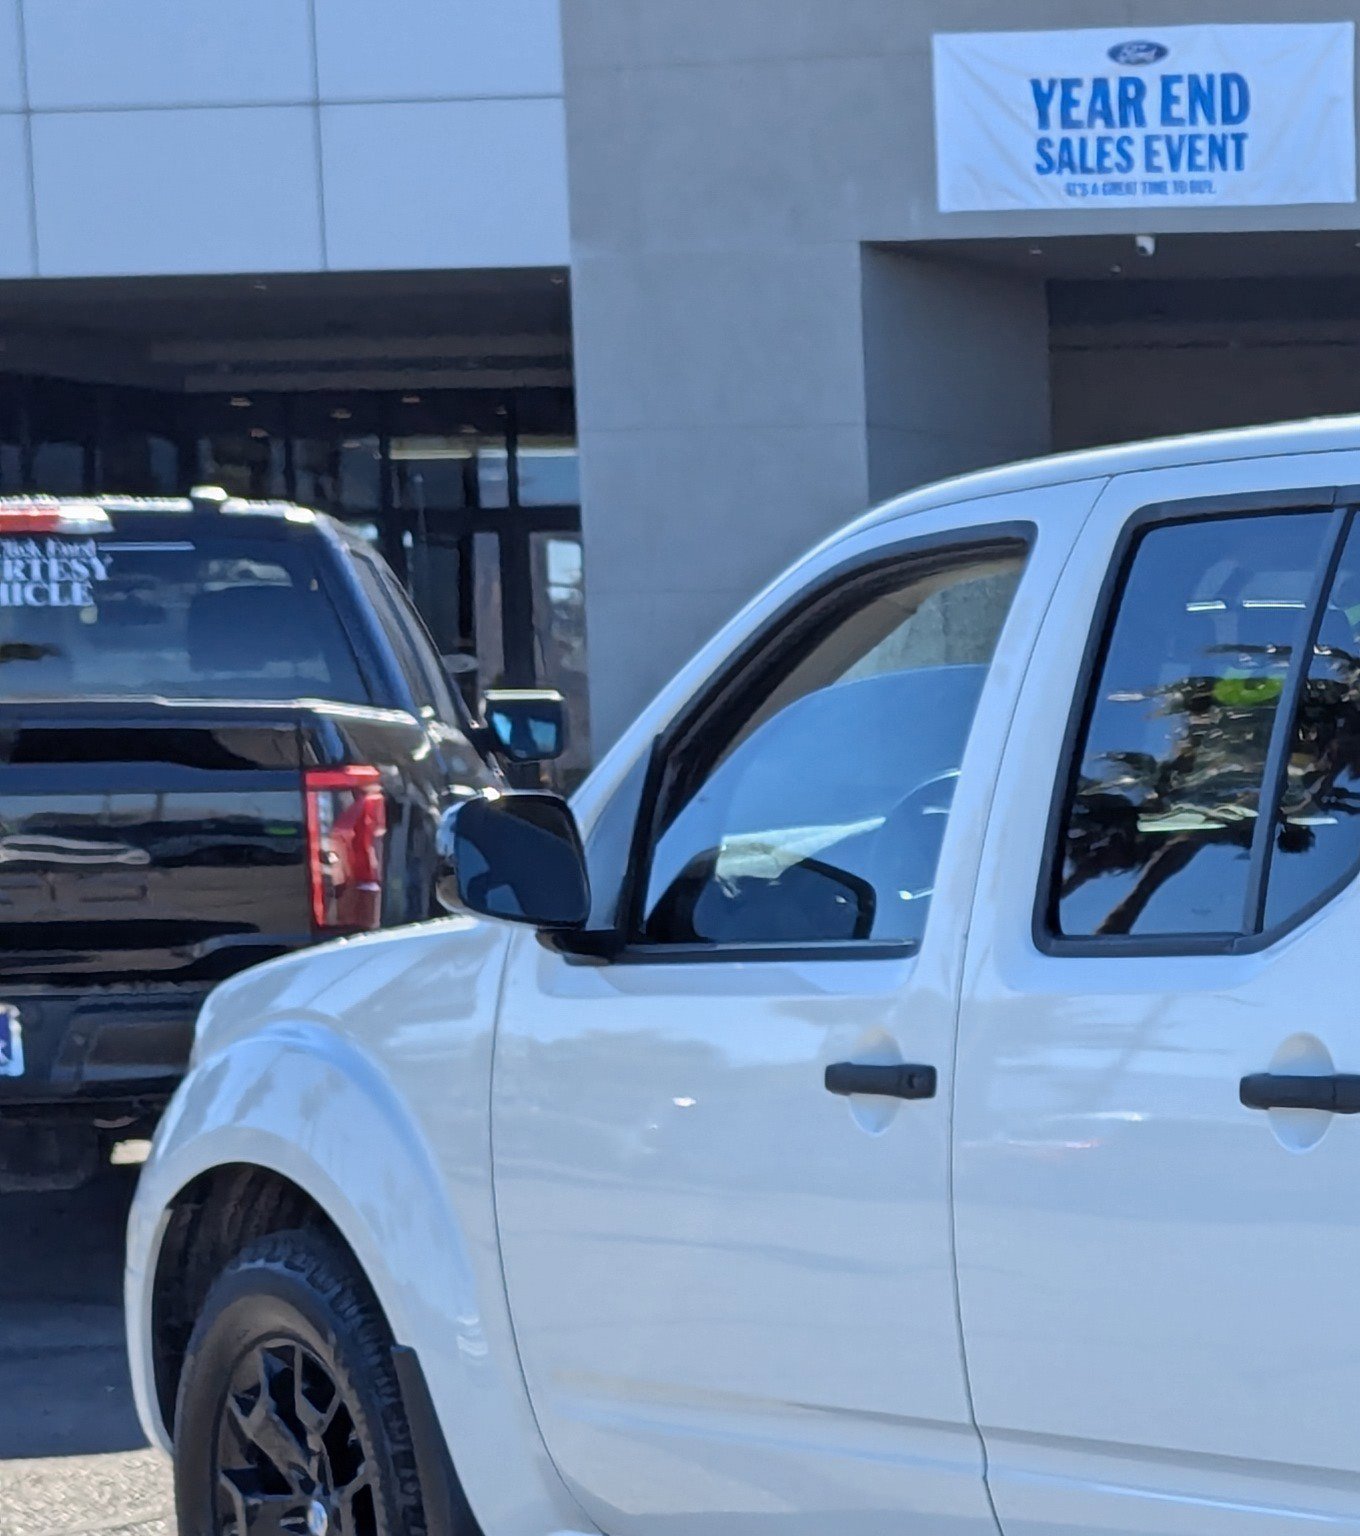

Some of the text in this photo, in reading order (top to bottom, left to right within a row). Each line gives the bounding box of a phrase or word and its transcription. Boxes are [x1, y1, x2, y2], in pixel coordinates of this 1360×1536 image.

[1030, 72, 1251, 131] YEAR END
[1035, 132, 1249, 176] SALES EVENT
